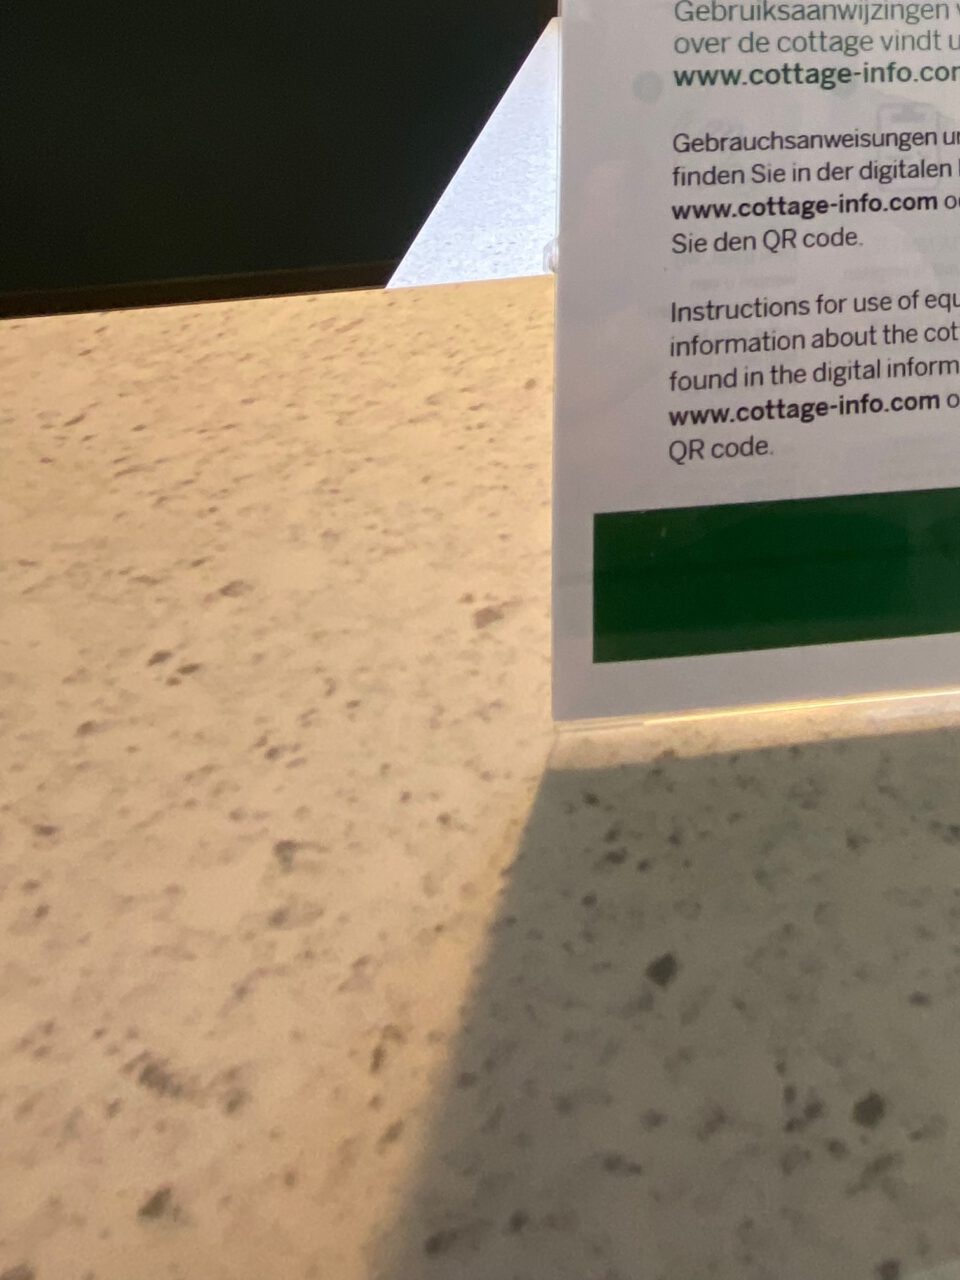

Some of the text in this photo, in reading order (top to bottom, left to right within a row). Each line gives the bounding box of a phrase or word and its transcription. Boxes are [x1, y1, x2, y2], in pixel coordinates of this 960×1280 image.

[674, 0, 950, 25] Gebruiksaanwijzingen
[674, 35, 730, 54] over
[738, 31, 769, 53] de
[777, 30, 874, 56] cottage
[882, 29, 942, 51] vindt
[673, 129, 937, 152] Gebrauchsanweisungen
[672, 166, 745, 186] finden
[751, 164, 785, 183] Sie
[793, 163, 811, 182] in
[817, 162, 853, 181] der
[859, 160, 952, 184] digitalen
[672, 194, 937, 220] www.cottage-info.com
[672, 227, 863, 254] Sie den QR code.
[671, 297, 810, 323] Instructions
[816, 294, 847, 314] for
[854, 296, 892, 312] use
[898, 290, 920, 310] of
[671, 330, 805, 357] information
[811, 326, 877, 349] about
[883, 324, 918, 344] the
[670, 368, 737, 391] found
[744, 366, 763, 386] in
[770, 365, 806, 385] the
[813, 359, 880, 387] digital
[669, 393, 940, 426] www.cottage-info.com
[669, 435, 774, 465] QR code.
